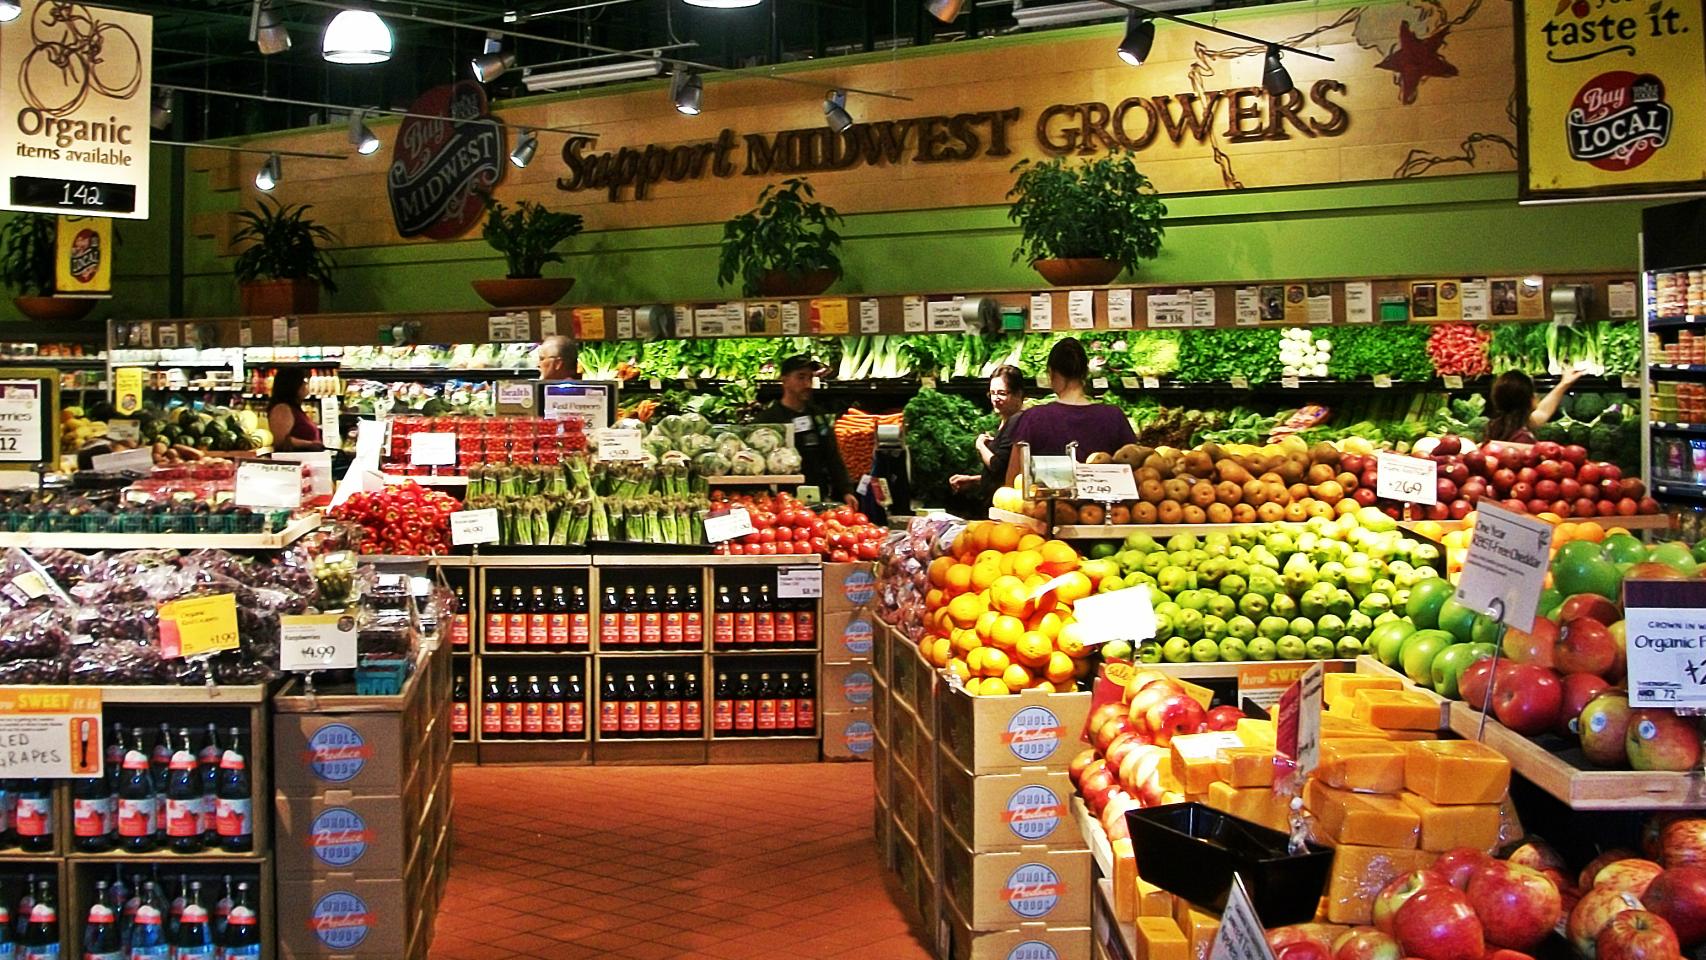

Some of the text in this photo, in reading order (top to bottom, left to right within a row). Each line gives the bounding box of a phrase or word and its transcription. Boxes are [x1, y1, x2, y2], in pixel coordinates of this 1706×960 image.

[1541, 7, 1689, 47] taste it.
[1583, 87, 1625, 112] Buy
[17, 106, 133, 149] Organic
[1578, 111, 1662, 152] LOCAL
[403, 114, 445, 160] Buy
[556, 79, 1350, 202] Support MIDWEST GROWERS
[16, 141, 133, 166] items available
[402, 131, 494, 222] MIDWEST
[58, 183, 104, 205] 142
[502, 387, 531, 397] health
[1648, 621, 1682, 630] GROWN
[1635, 635, 1698, 652] Organic
[18, 694, 70, 709] SWEET
[1663, 690, 1676, 699] 72
[1017, 715, 1052, 726] WHOLE
[1018, 744, 1051, 754] FOODS
[1017, 794, 1052, 805] WHOLE
[319, 817, 360, 828] WHOLE
[1018, 822, 1051, 833] FOODS
[1016, 873, 1053, 882] WHOLE
[1017, 900, 1051, 910] FOODS
